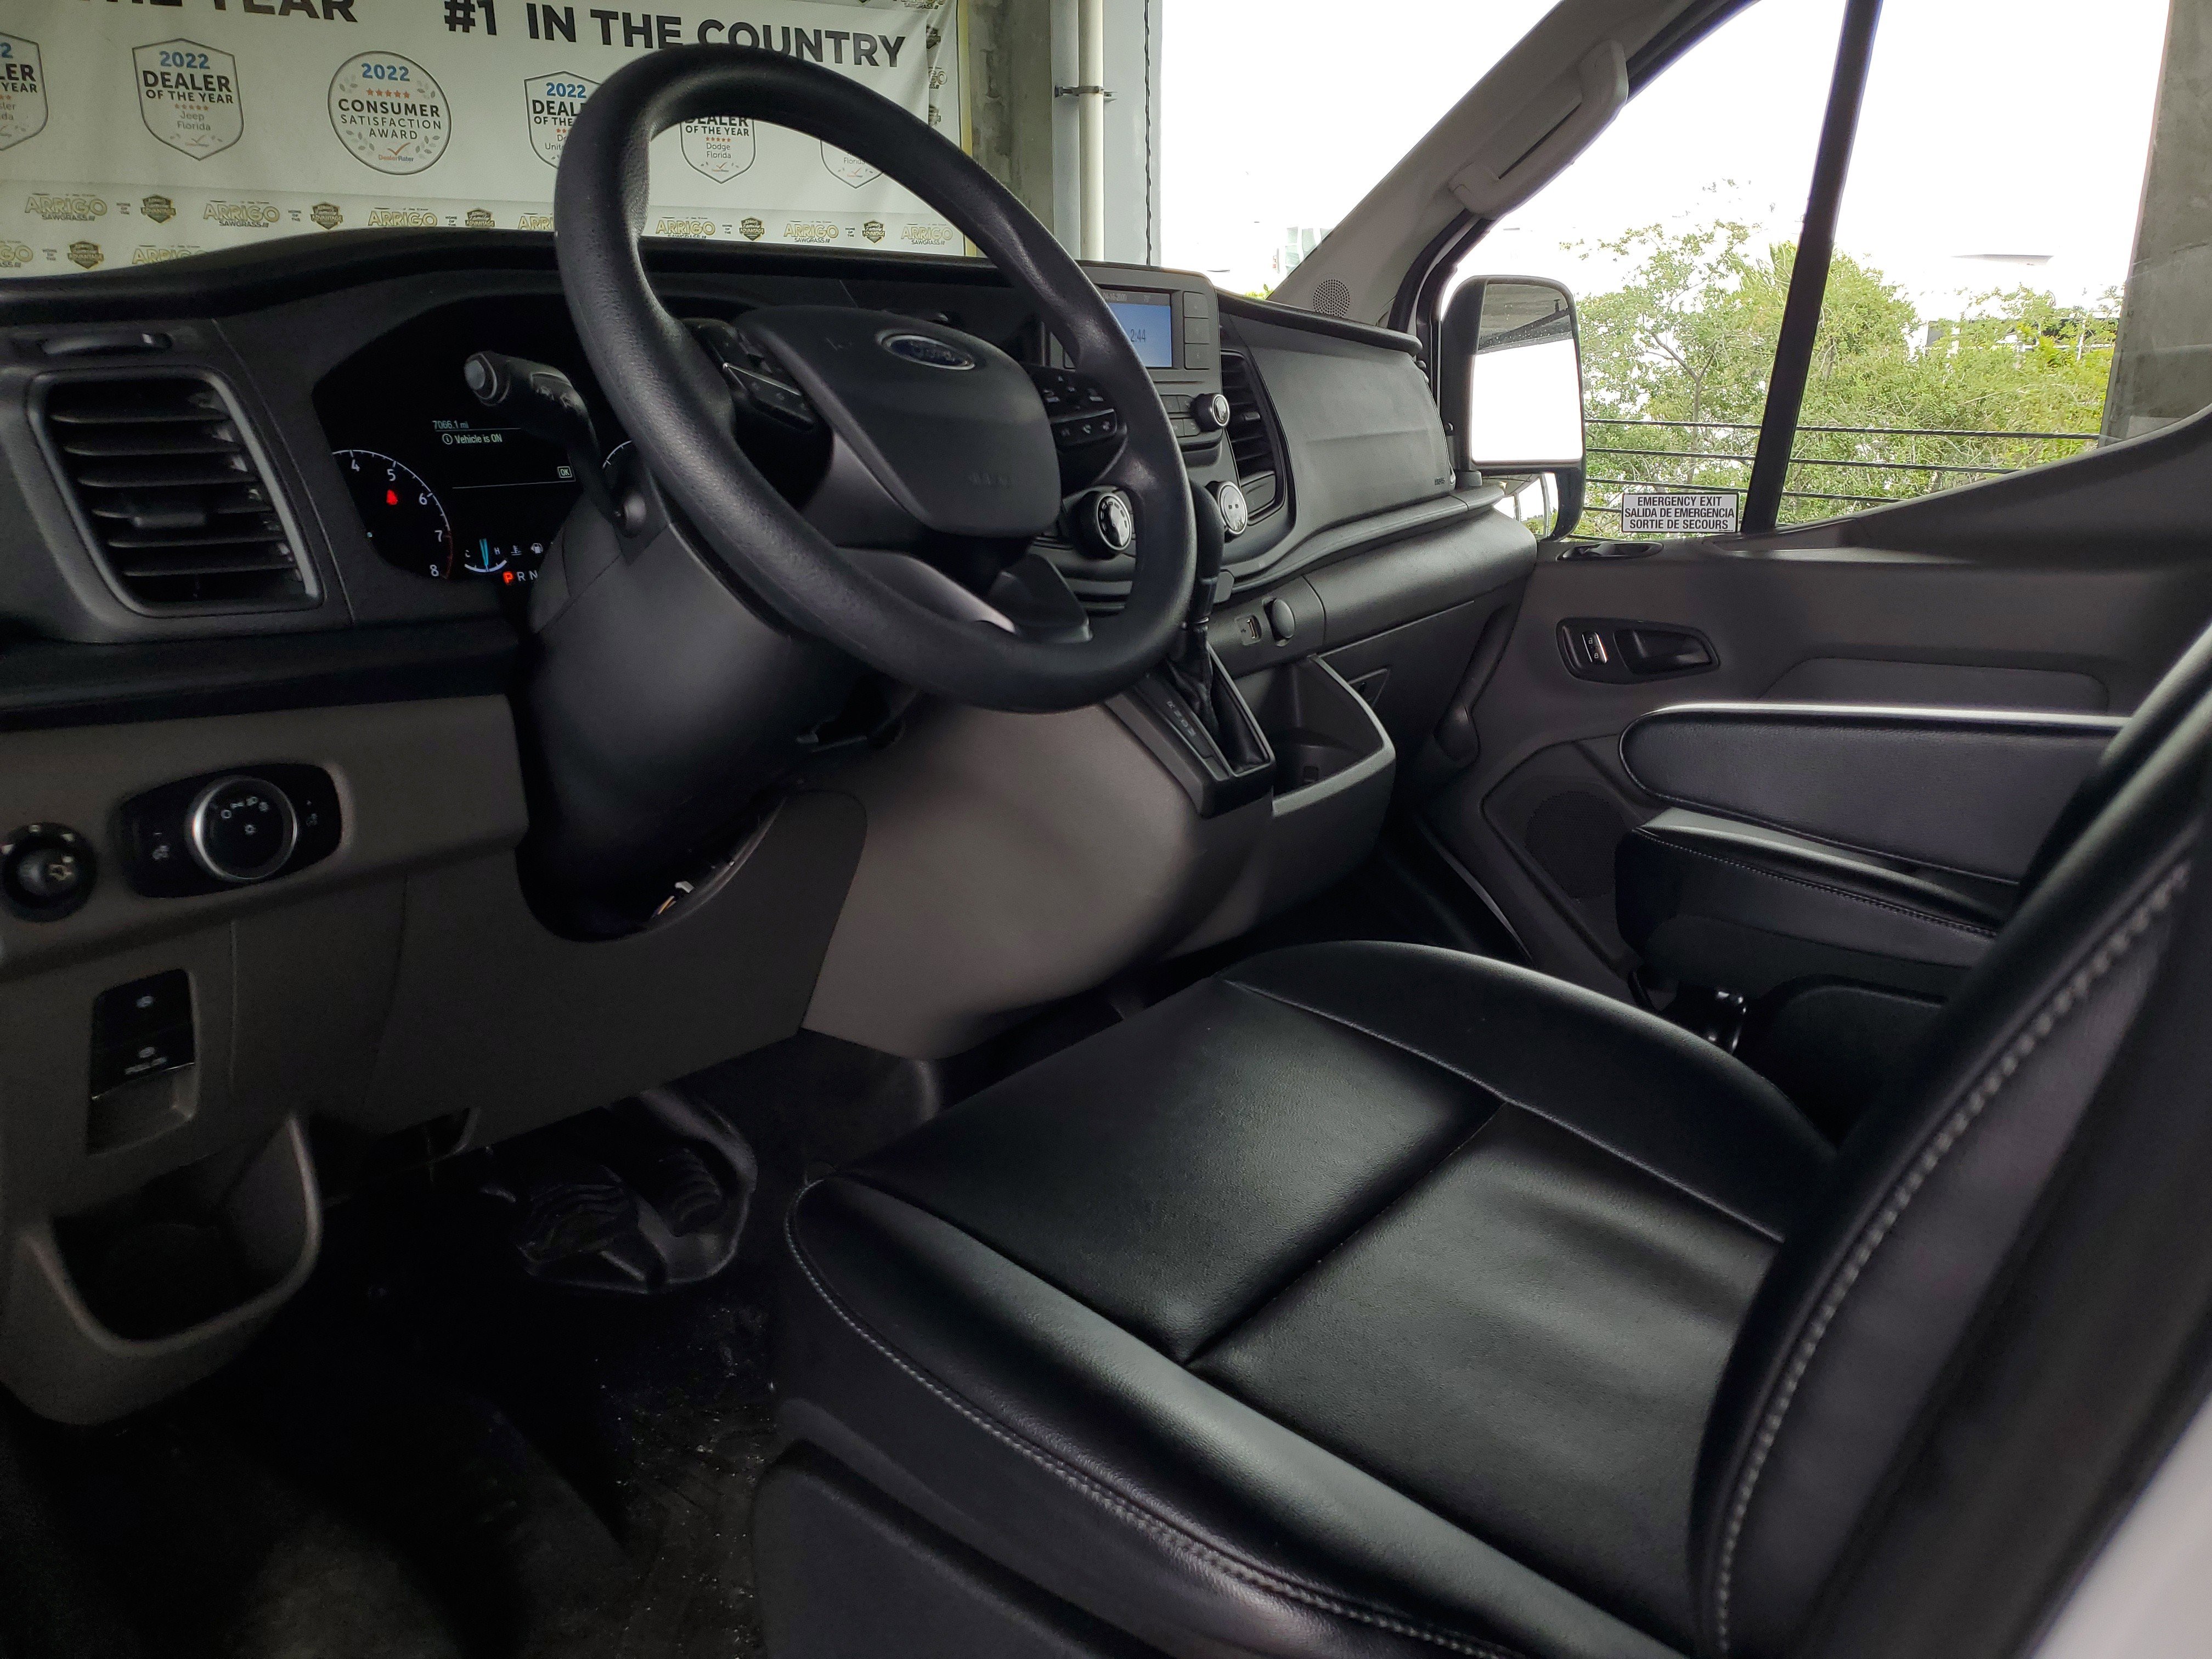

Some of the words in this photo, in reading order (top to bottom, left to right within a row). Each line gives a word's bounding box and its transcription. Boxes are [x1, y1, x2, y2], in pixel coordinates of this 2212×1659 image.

[215, 0, 358, 22] AR
[444, 0, 496, 36] #1
[527, 3, 576, 42] IN
[590, 9, 682, 49] THE
[698, 19, 906, 67] COUNTRY
[160, 51, 210, 69] 2022
[361, 63, 410, 81] 2022
[2, 82, 38, 93] YEAR
[143, 70, 232, 92] DEALER
[146, 89, 163, 99] OF
[167, 91, 195, 101] THE
[199, 92, 234, 104] YEAR
[546, 82, 586, 98] 2022
[338, 98, 440, 117] CONSUMER
[532, 99, 588, 116] DEAL
[180, 110, 205, 120] Jeep
[341, 114, 441, 129] SATISFACTION
[534, 116, 548, 125] OF
[551, 117, 573, 126] THE
[177, 120, 211, 131] Florida
[686, 125, 698, 133] OF
[701, 126, 721, 134] THE
[724, 127, 749, 136] YEAR
[369, 128, 417, 139] AWARD
[706, 142, 730, 151] Dodge
[25, 196, 108, 216] ARRIGO
[204, 202, 280, 223] ARRIGO
[368, 211, 437, 227] ARRIGO
[517, 215, 555, 230] ARRI
[656, 219, 715, 235] ARRIGO
[783, 223, 839, 239] ARRIGO
[901, 225, 953, 240] ARRIGO
[132, 247, 208, 264] ARRIG
[1131, 329, 1146, 343] 2:44
[432, 420, 459, 430] 7066.1
[454, 433, 482, 444] Vehicle
[482, 435, 490, 443] is
[491, 433, 503, 443] ON
[351, 459, 360, 472] 4
[387, 469, 396, 481] 5
[419, 493, 427, 505] 6
[1637, 496, 1696, 506] EMERGENCY
[1700, 496, 1723, 506] EXIT
[1624, 507, 1657, 517] SALIDA
[1660, 508, 1672, 517] DE
[1674, 508, 1735, 518] EMERGENCIA
[1629, 520, 1664, 529] SORTIE
[1667, 520, 1680, 529] DE
[1683, 520, 1728, 529] SECOURS
[435, 530, 443, 542] 7
[430, 565, 439, 577] 8
[503, 571, 514, 584] P
[517, 571, 526, 582] R
[528, 570, 538, 580] N
